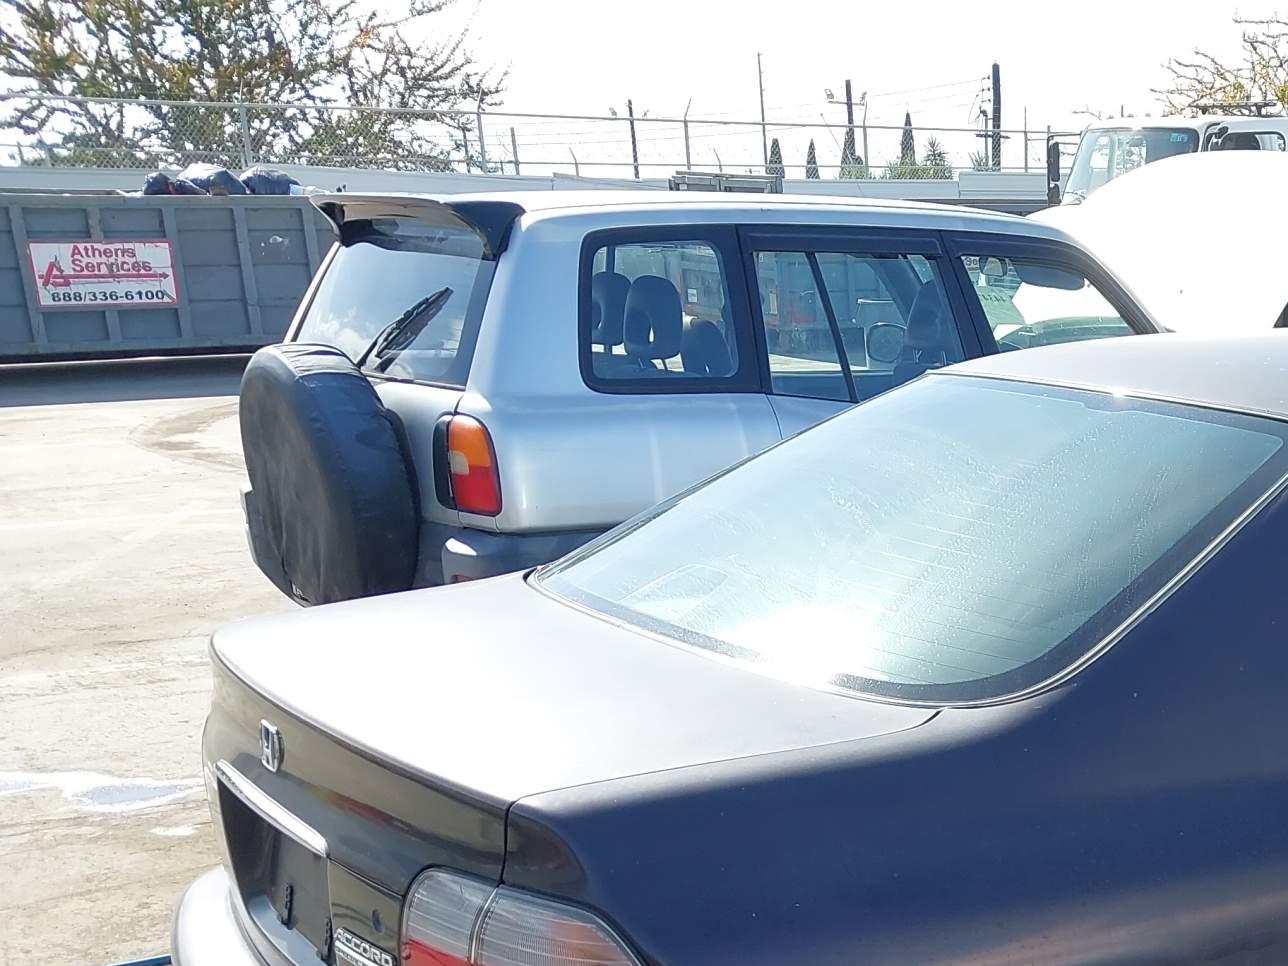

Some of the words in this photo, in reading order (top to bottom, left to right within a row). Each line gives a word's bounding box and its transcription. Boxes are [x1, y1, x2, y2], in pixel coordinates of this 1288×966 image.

[71, 244, 136, 258] Athens
[71, 258, 153, 273] Services
[51, 290, 165, 303] 888/336-6100
